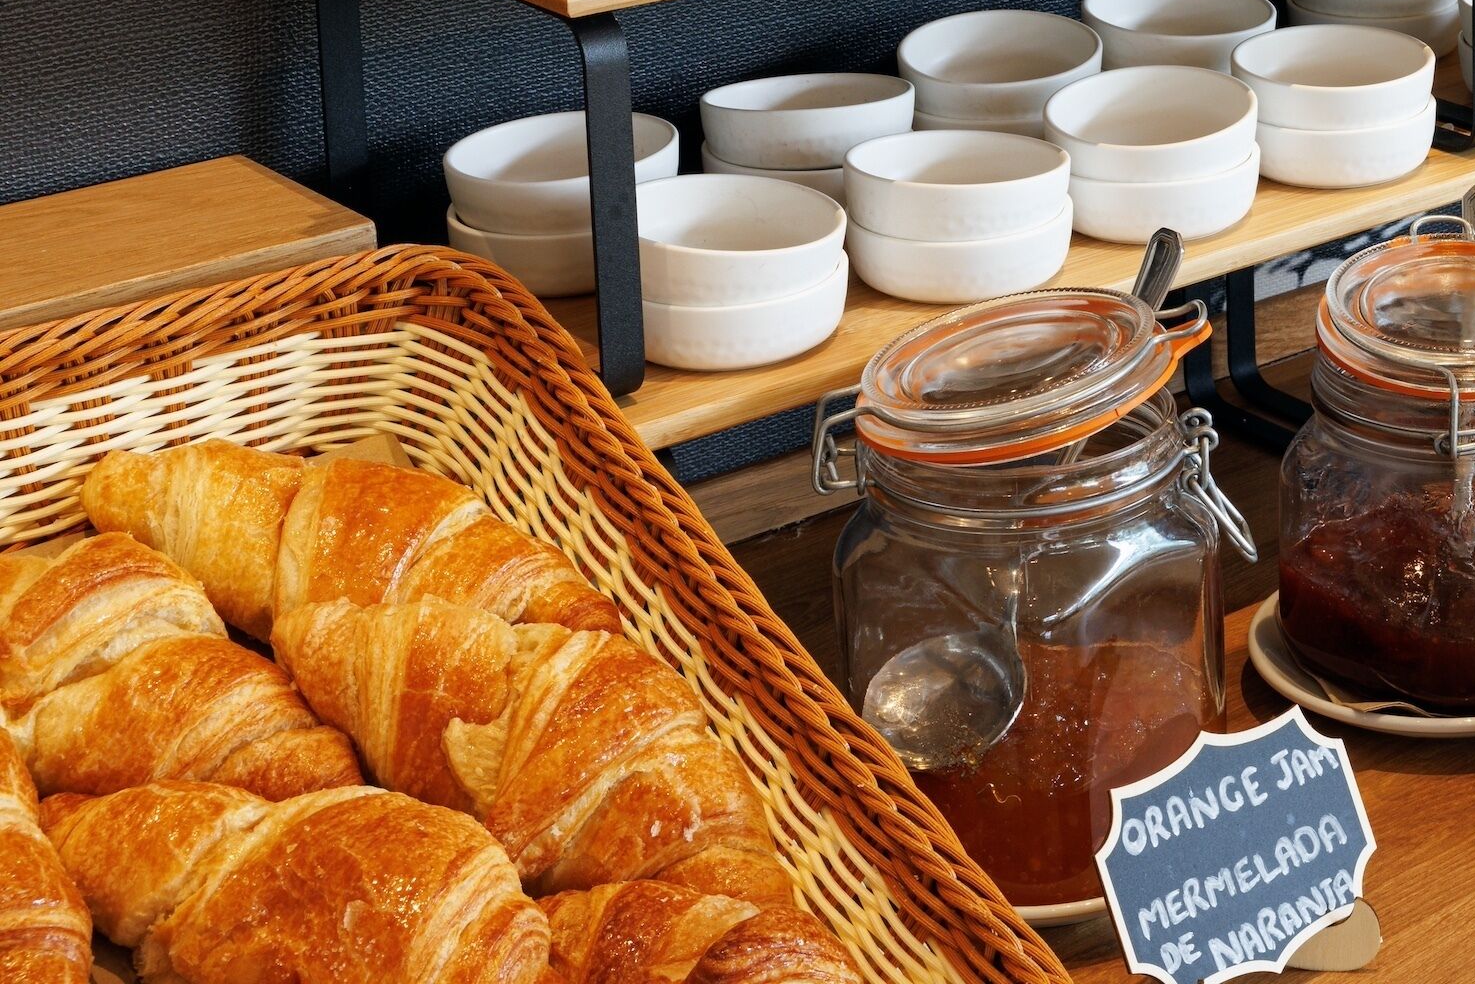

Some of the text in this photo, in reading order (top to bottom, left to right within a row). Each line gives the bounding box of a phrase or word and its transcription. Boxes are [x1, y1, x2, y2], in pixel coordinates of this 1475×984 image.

[1121, 746, 1339, 856] ORANGE JAM
[1137, 813, 1348, 941] MERMELADA
[1159, 868, 1356, 975] DE NARANJA
